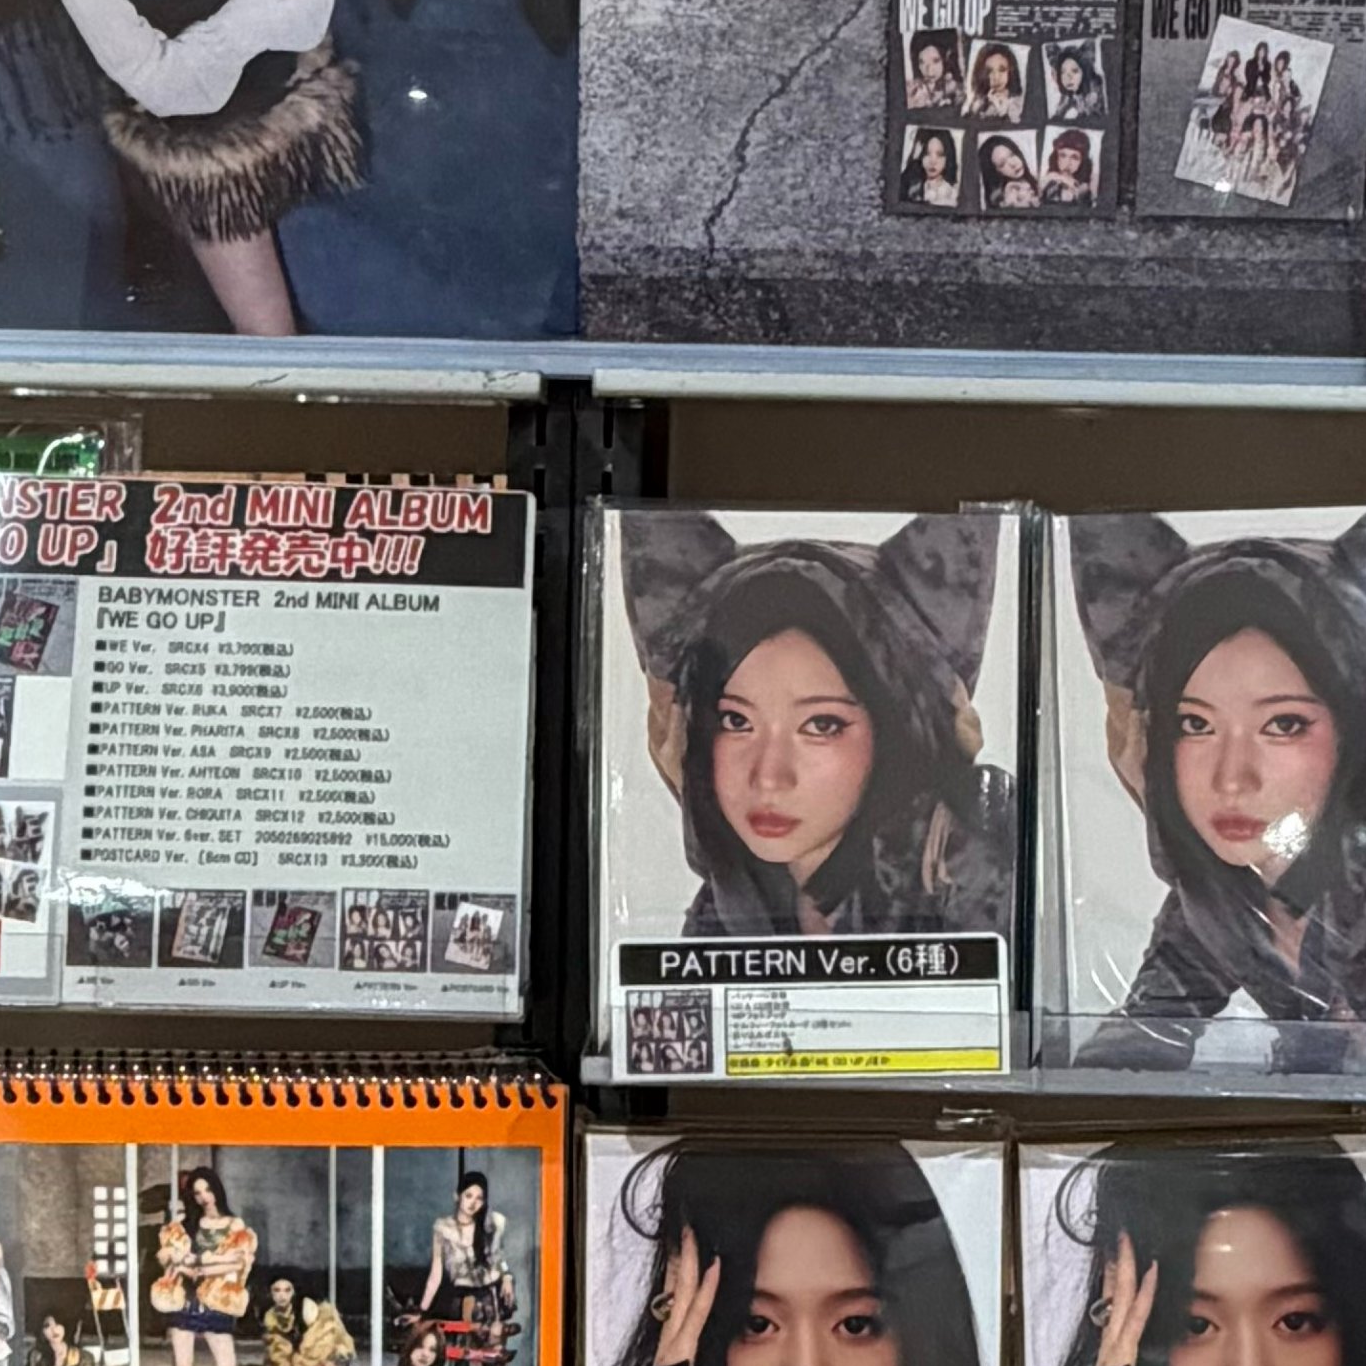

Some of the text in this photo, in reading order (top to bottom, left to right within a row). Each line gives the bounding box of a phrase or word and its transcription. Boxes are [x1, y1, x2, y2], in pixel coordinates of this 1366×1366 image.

[151, 483, 231, 523] 2nd
[246, 486, 353, 527] MINI
[353, 490, 493, 534] ALBUM
[146, 531, 425, 578] 好評発売中!!!
[97, 586, 441, 613] BABYMONSTER 2nd MINI ALBUM
[146, 610, 178, 630] GO
[103, 701, 162, 716] PATTERN
[102, 723, 161, 736] PATTERN
[100, 743, 159, 757] PATTERN
[99, 764, 158, 778] PATTERN
[97, 785, 156, 799] PATTERN
[96, 806, 154, 820] PATTERN
[94, 827, 153, 841] PATTERN
[93, 848, 161, 863] POSTCARD
[659, 942, 960, 979] PATTERN Ver. (6種)
